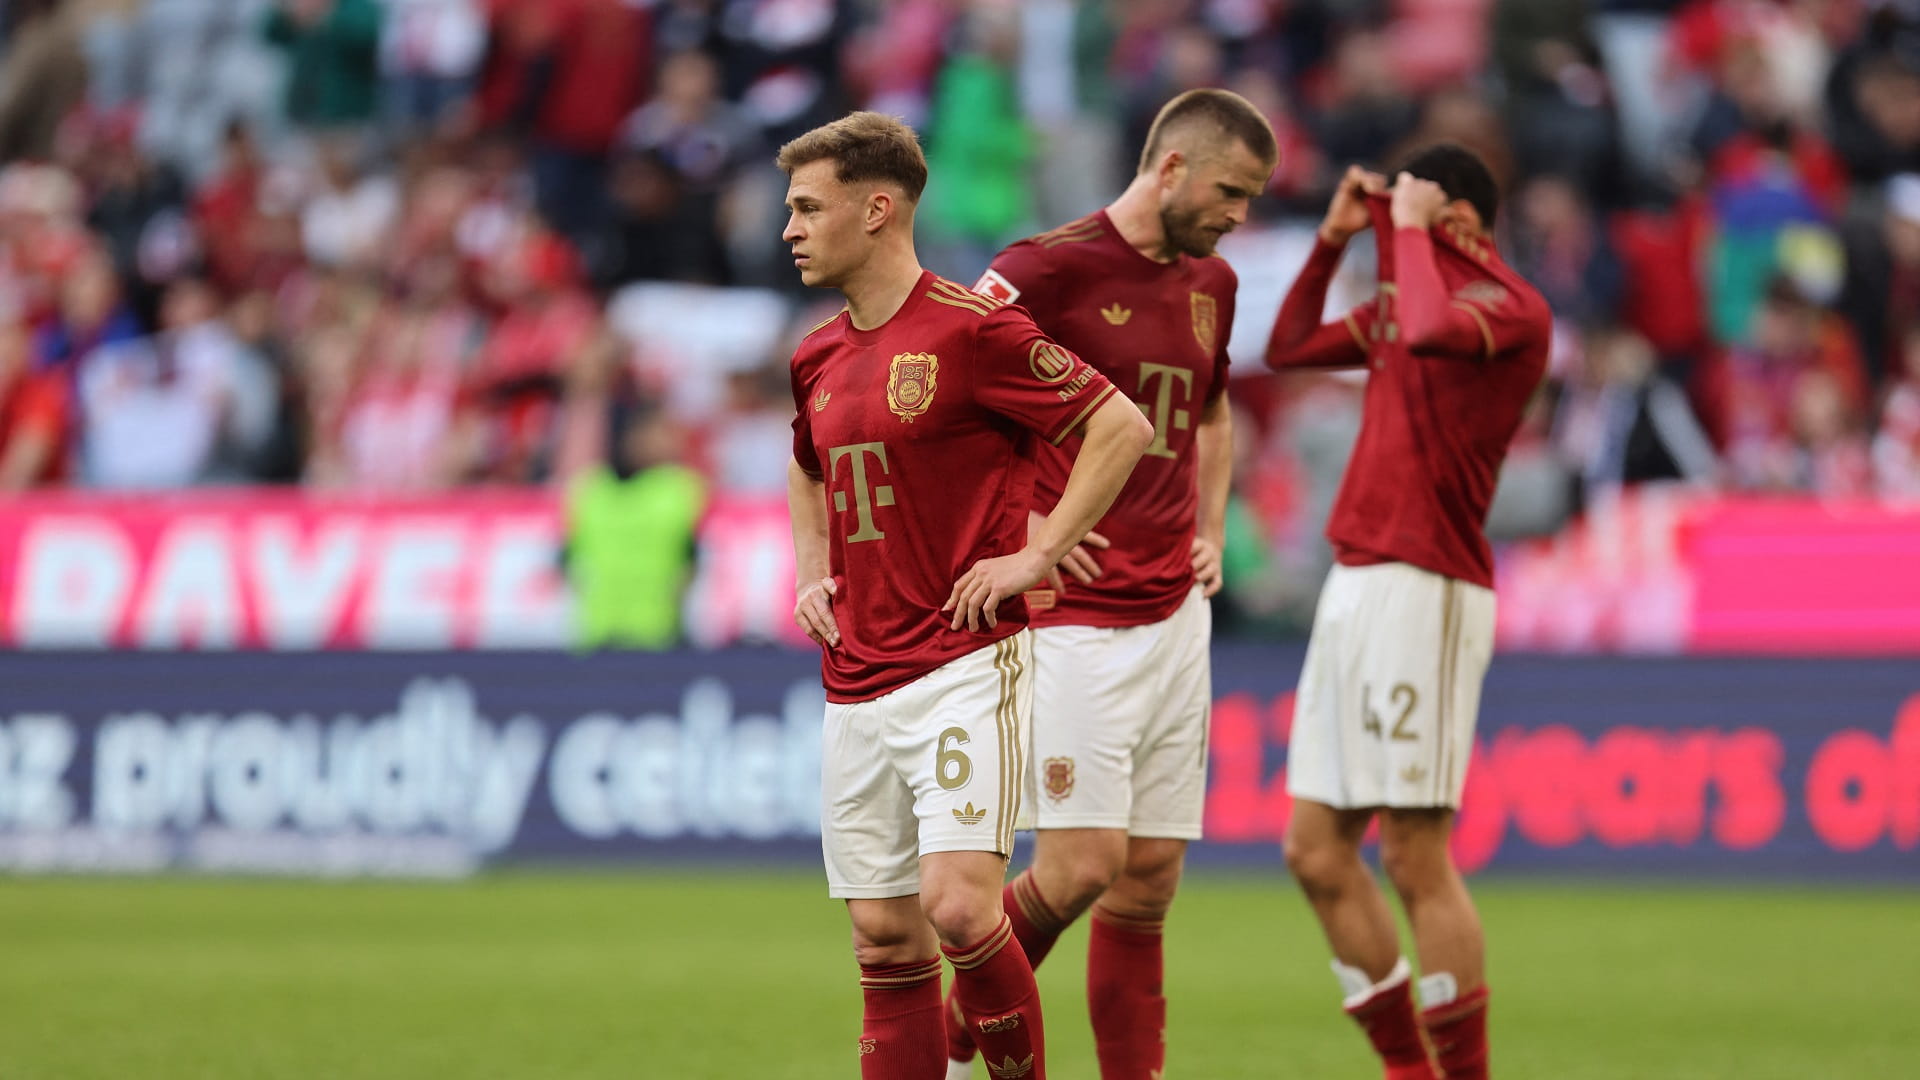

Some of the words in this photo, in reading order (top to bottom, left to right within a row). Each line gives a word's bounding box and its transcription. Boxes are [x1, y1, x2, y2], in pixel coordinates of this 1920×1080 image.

[902, 365, 924, 379] 125
[1136, 362, 1194, 459] T
[828, 441, 895, 544] T
[1362, 681, 1420, 741] 42
[94, 678, 548, 855] proudly
[936, 726, 973, 791] 6
